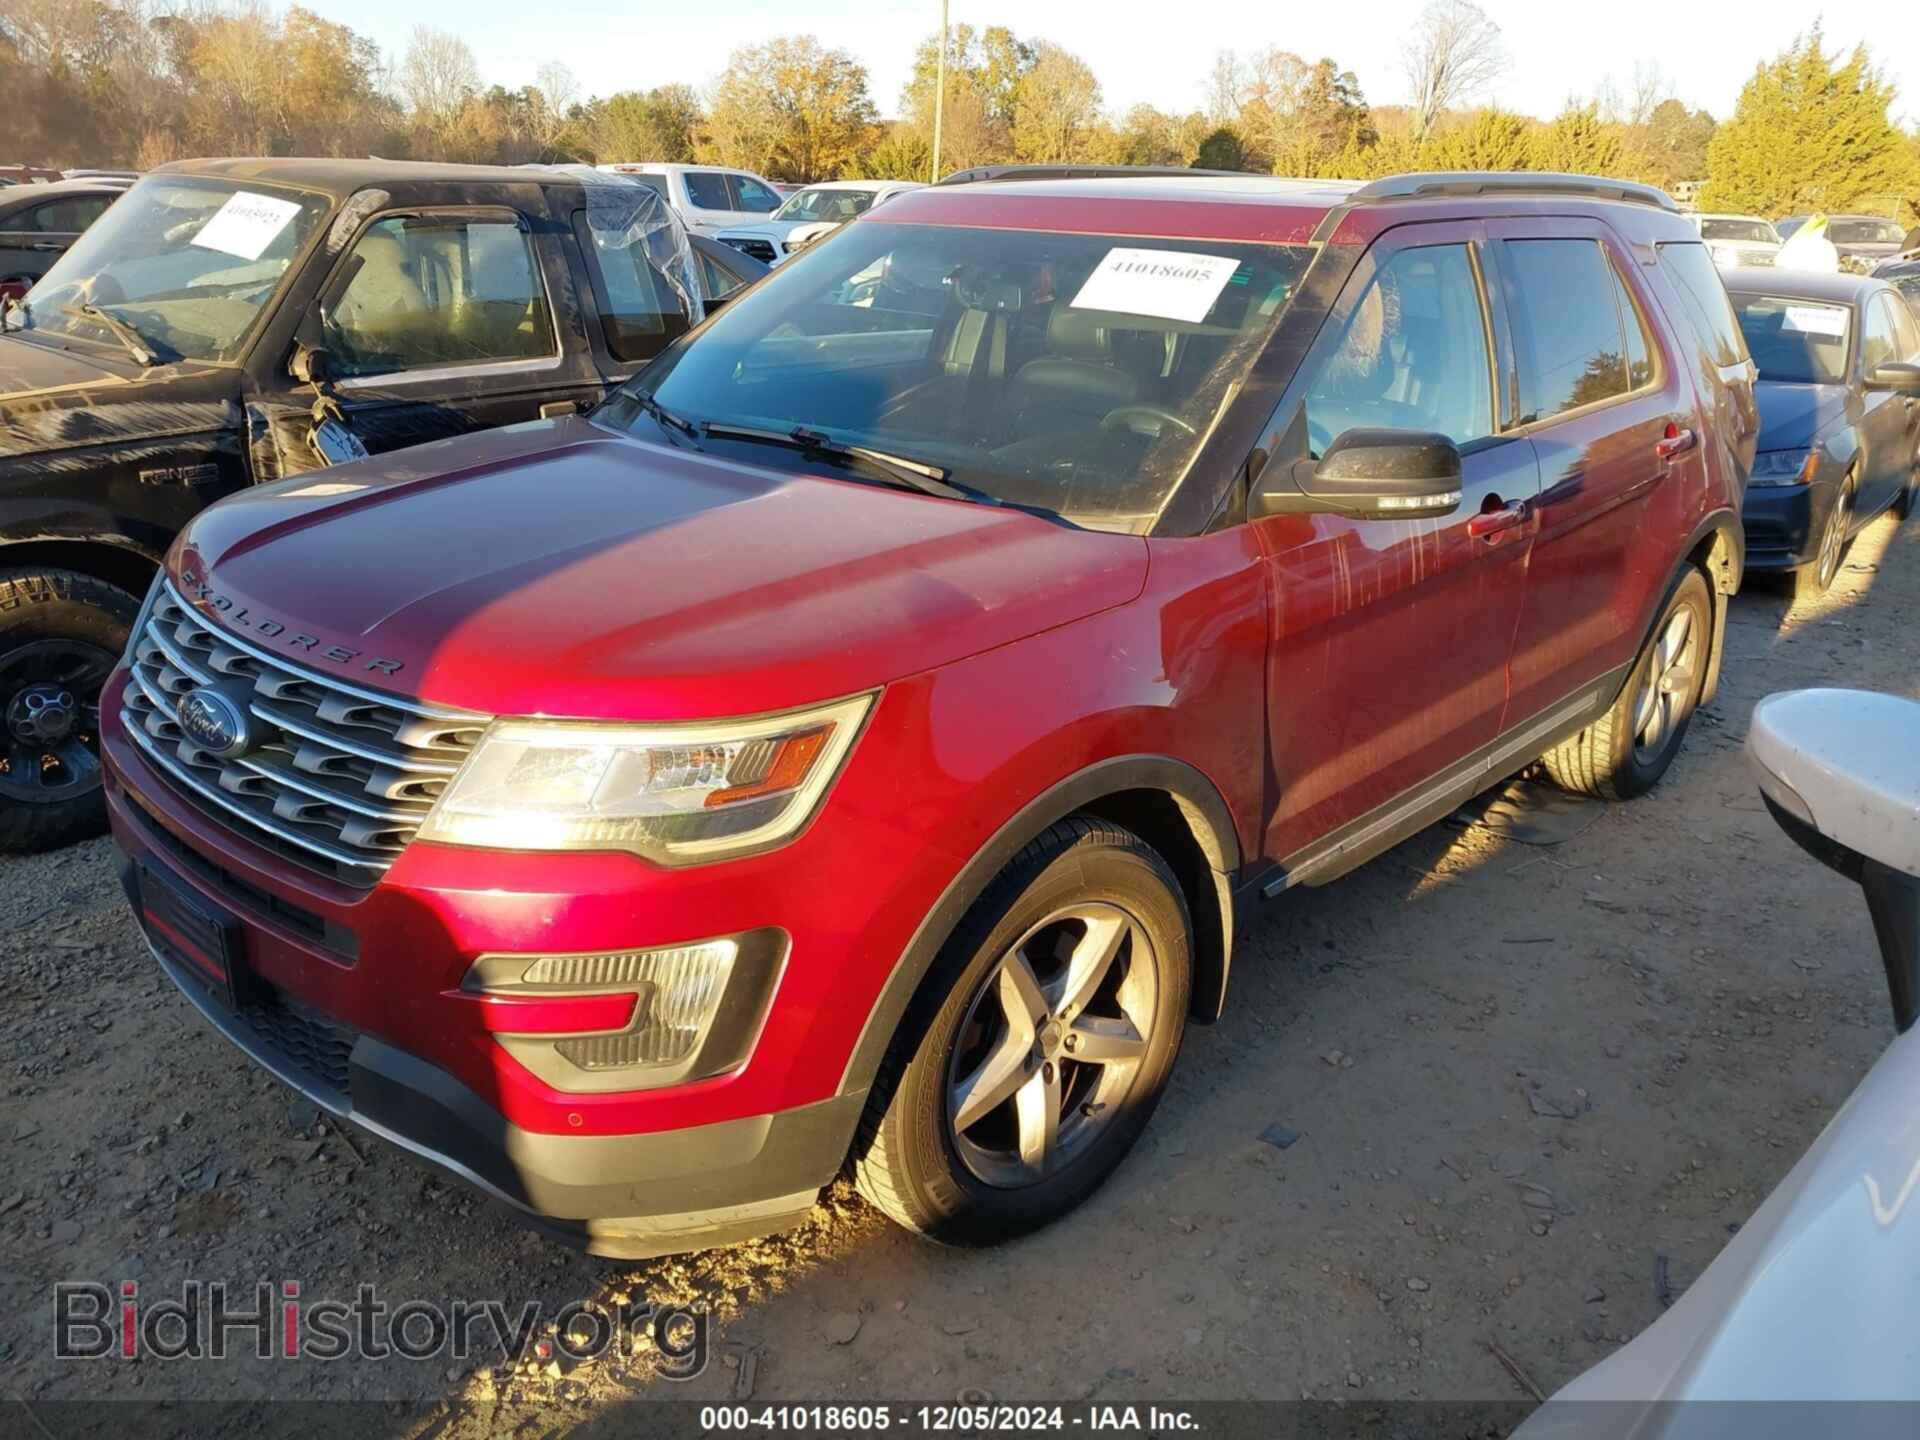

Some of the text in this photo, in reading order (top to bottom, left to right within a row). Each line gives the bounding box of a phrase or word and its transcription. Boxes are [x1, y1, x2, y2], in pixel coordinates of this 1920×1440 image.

[1111, 261, 1214, 281] 41018605
[181, 568, 404, 675] EXPLORER
[190, 698, 223, 742] Ford
